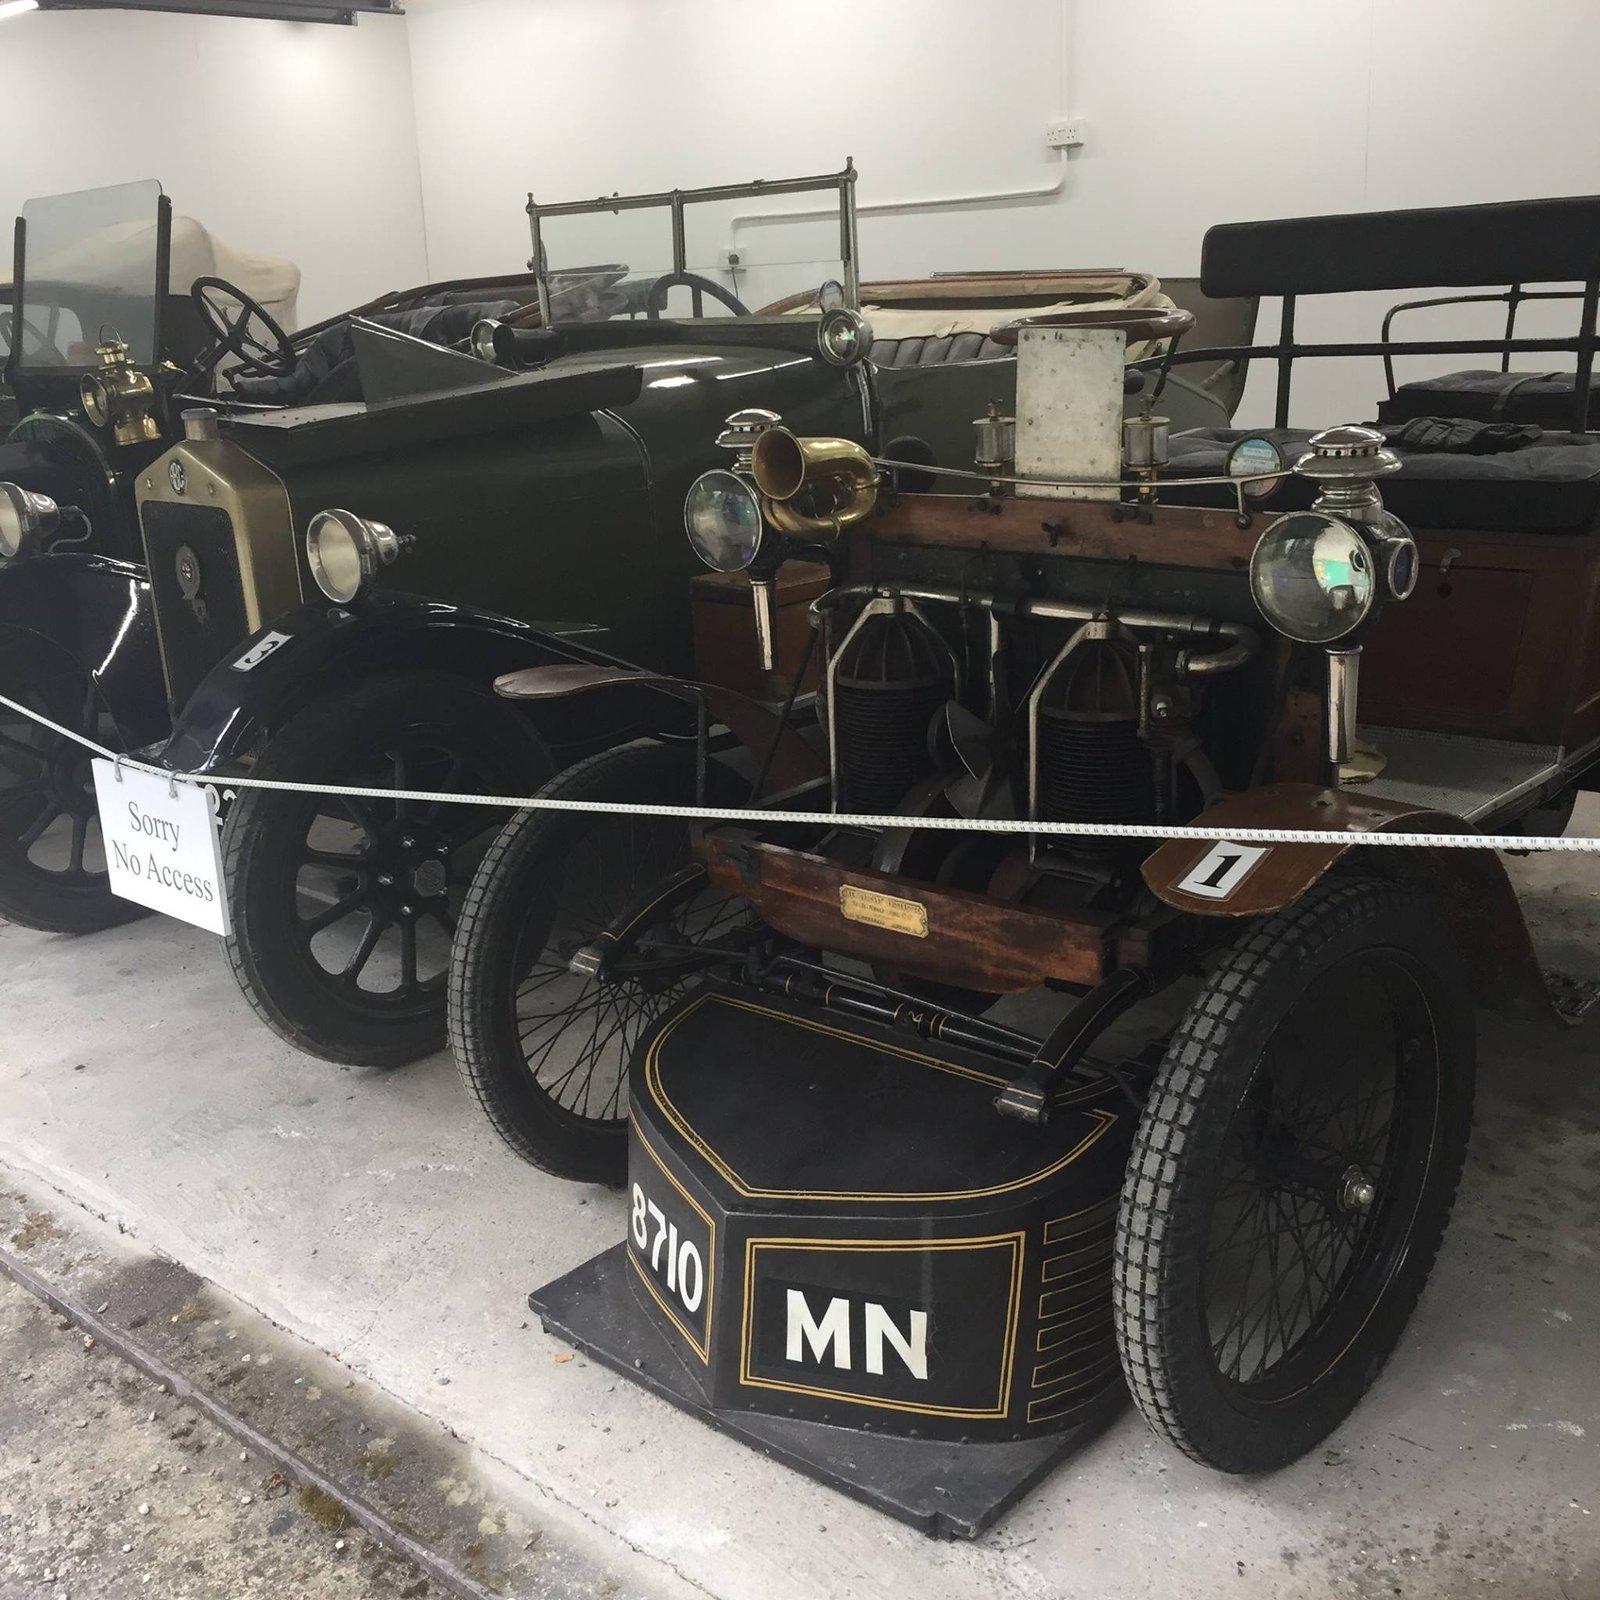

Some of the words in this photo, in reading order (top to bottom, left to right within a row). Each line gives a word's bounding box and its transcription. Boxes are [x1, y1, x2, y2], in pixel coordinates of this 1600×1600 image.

[244, 640, 280, 664] 3
[128, 801, 180, 852] Sorry
[111, 839, 141, 876] No
[147, 853, 214, 902] Access
[1193, 854, 1243, 889] 1
[632, 1182, 703, 1313] 8710
[786, 1288, 928, 1380] MN
